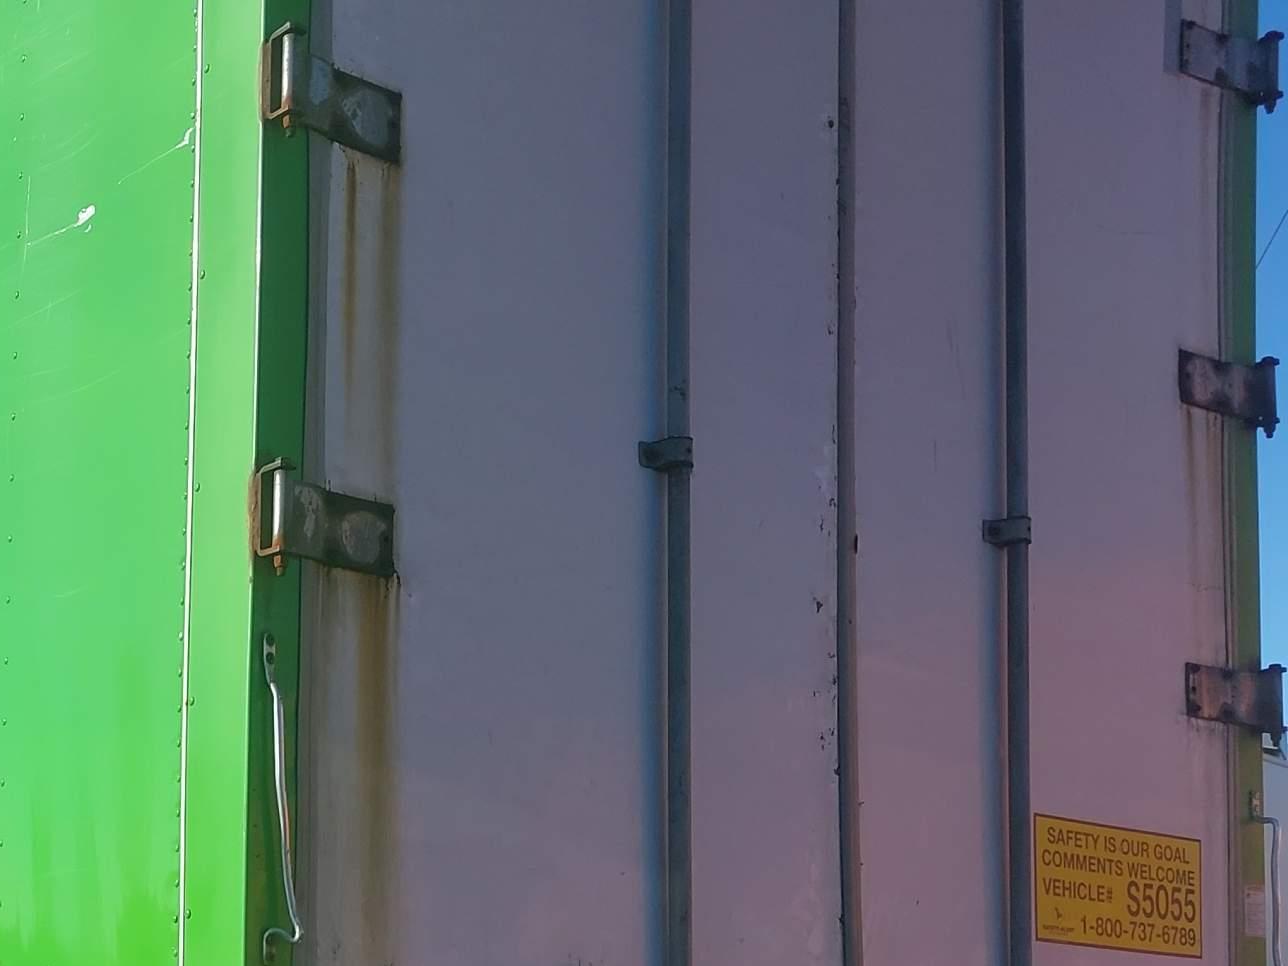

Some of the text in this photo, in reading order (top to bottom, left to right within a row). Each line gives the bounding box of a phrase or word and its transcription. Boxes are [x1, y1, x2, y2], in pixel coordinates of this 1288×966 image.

[1047, 826, 1190, 865] SAFETY IS OUR GOAL
[1042, 849, 1195, 887] COMMENTS WELCOME
[1042, 877, 1196, 923] VEHICLE# S5055
[1080, 915, 1197, 947] 1-800-737-6789
